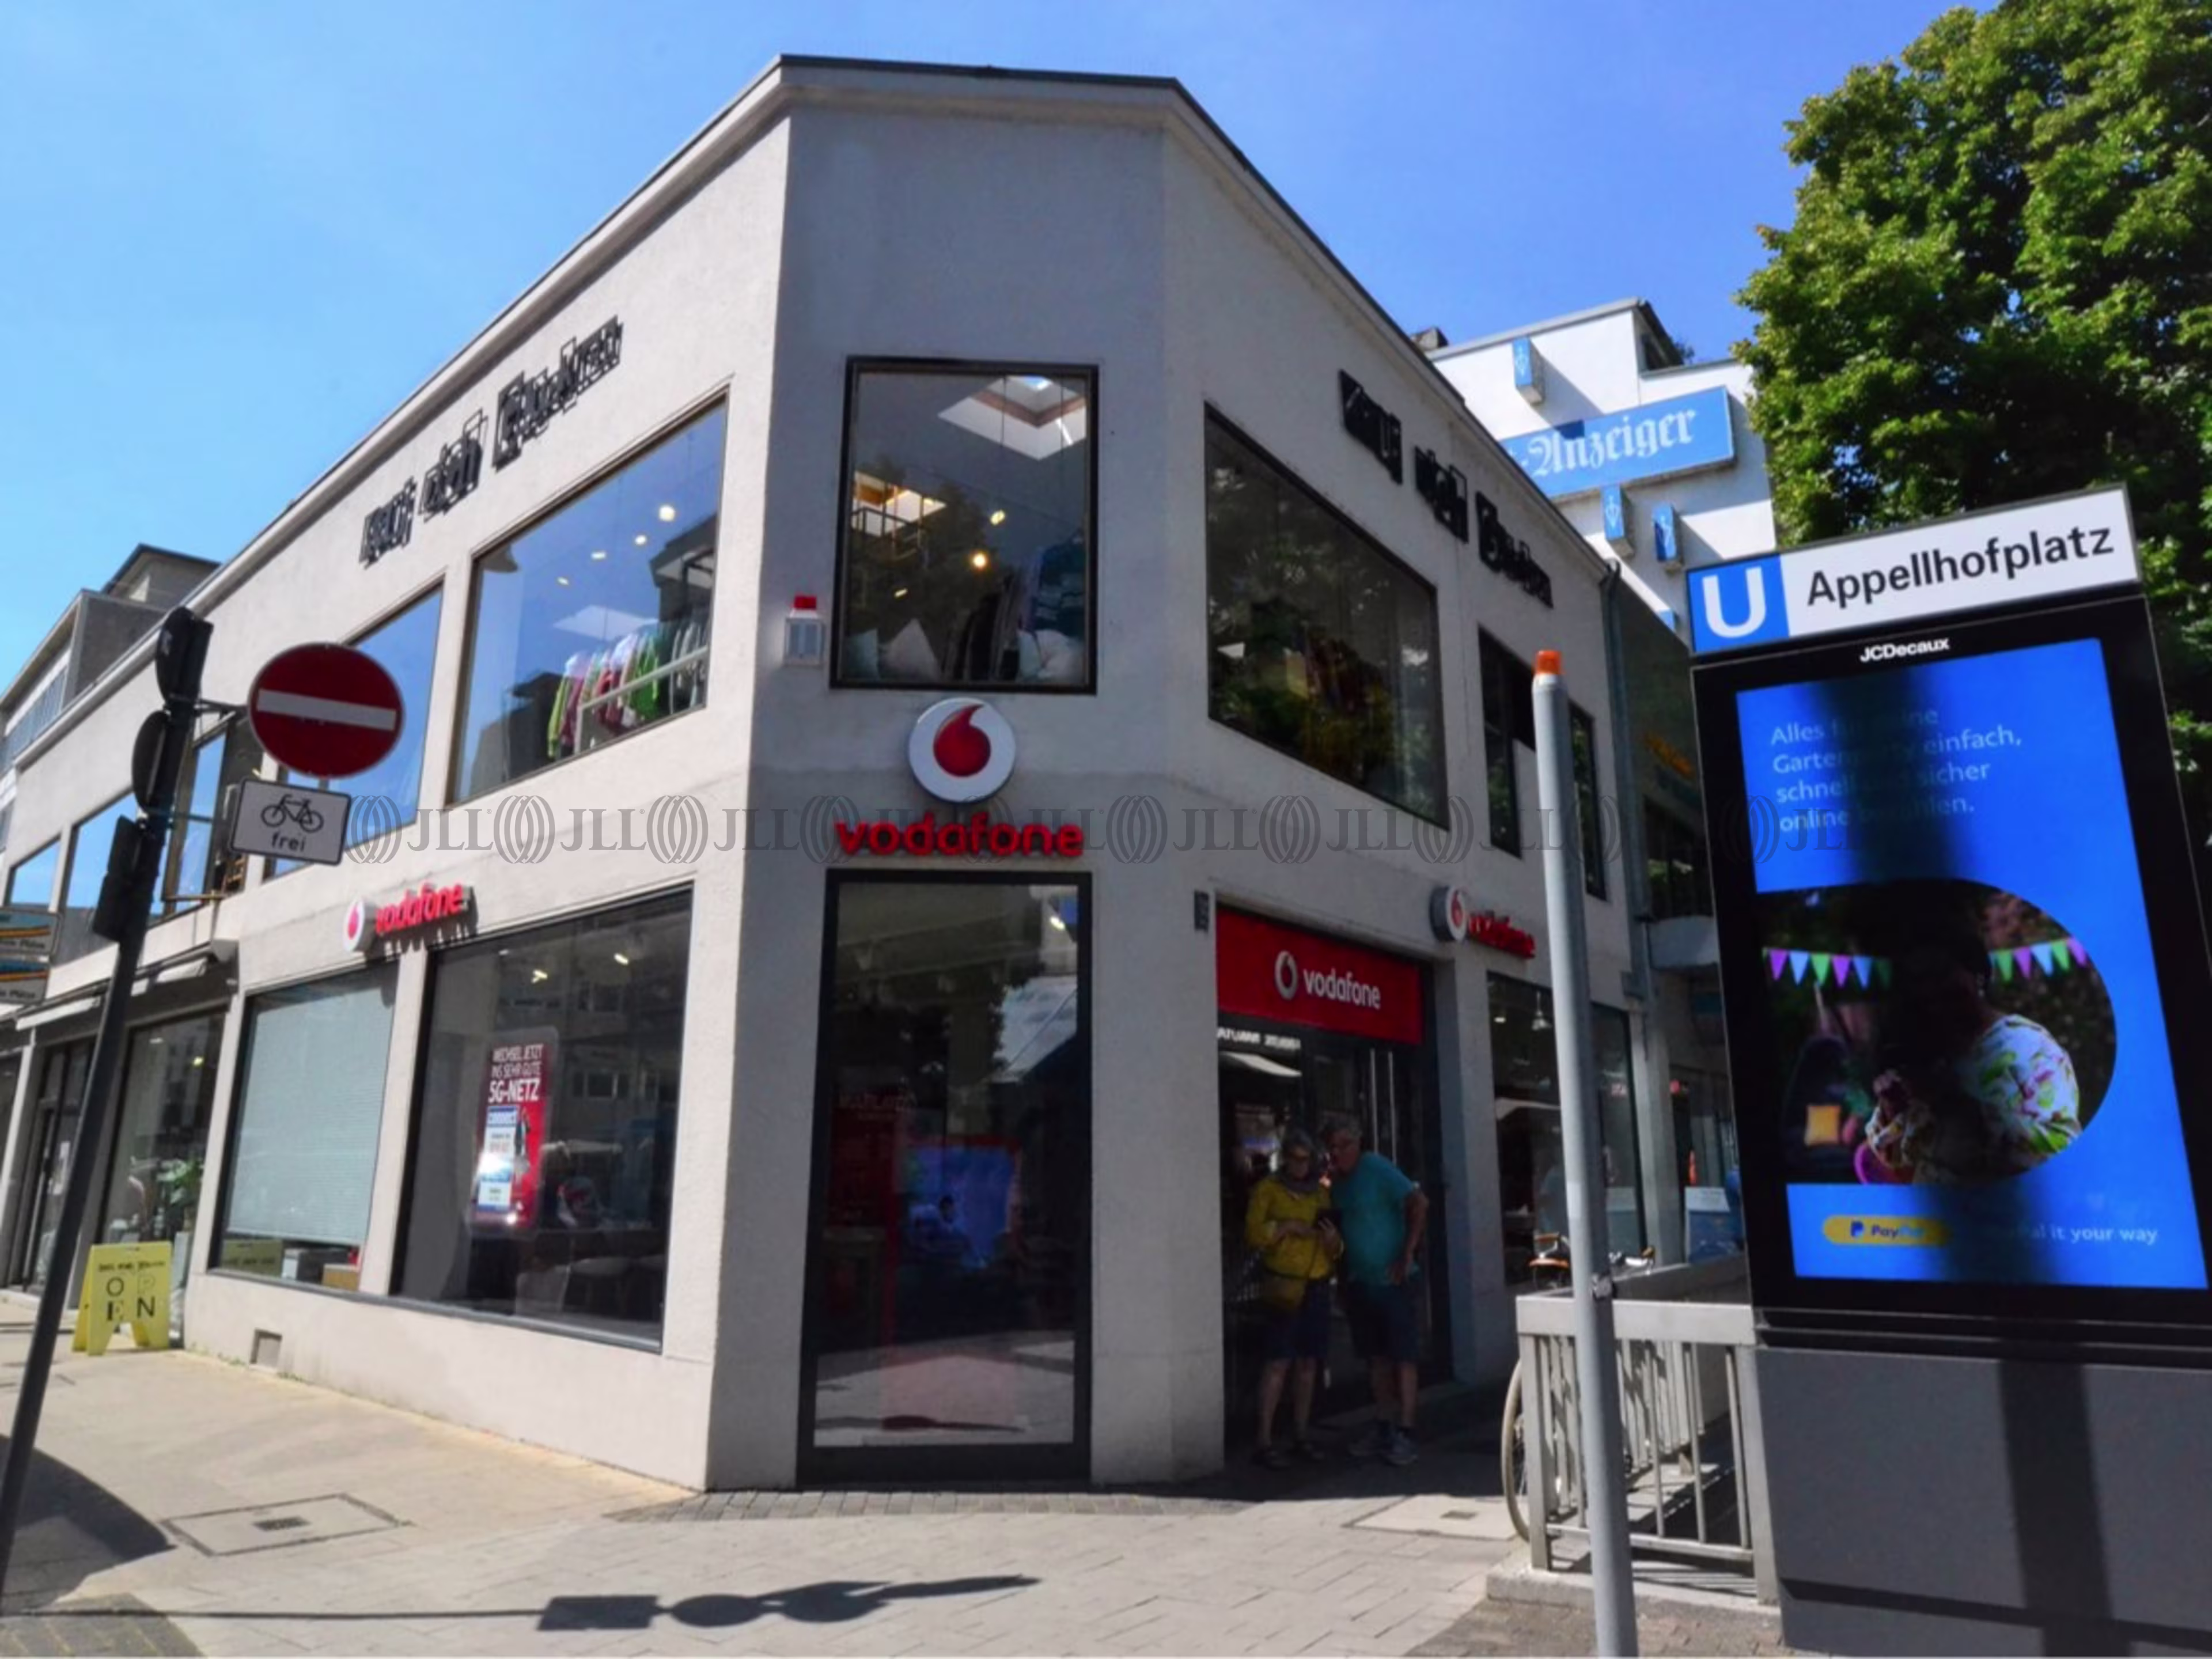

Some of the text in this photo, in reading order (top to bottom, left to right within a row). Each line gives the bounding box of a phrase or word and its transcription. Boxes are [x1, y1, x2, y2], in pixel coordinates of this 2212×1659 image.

[1702, 524, 2115, 639] U Appellhofplatz
[1859, 638, 1950, 662] JCDecaux
[1770, 722, 1824, 746] Alles
[1923, 724, 2022, 755] einfach,
[1779, 807, 1852, 833] online
[271, 831, 306, 853] frei
[835, 812, 1085, 858] vodafone
[376, 883, 463, 934] vodafone
[1303, 966, 1381, 1010] vodafone
[2070, 1227, 2113, 1245] your
[2119, 1228, 2158, 1246] way
